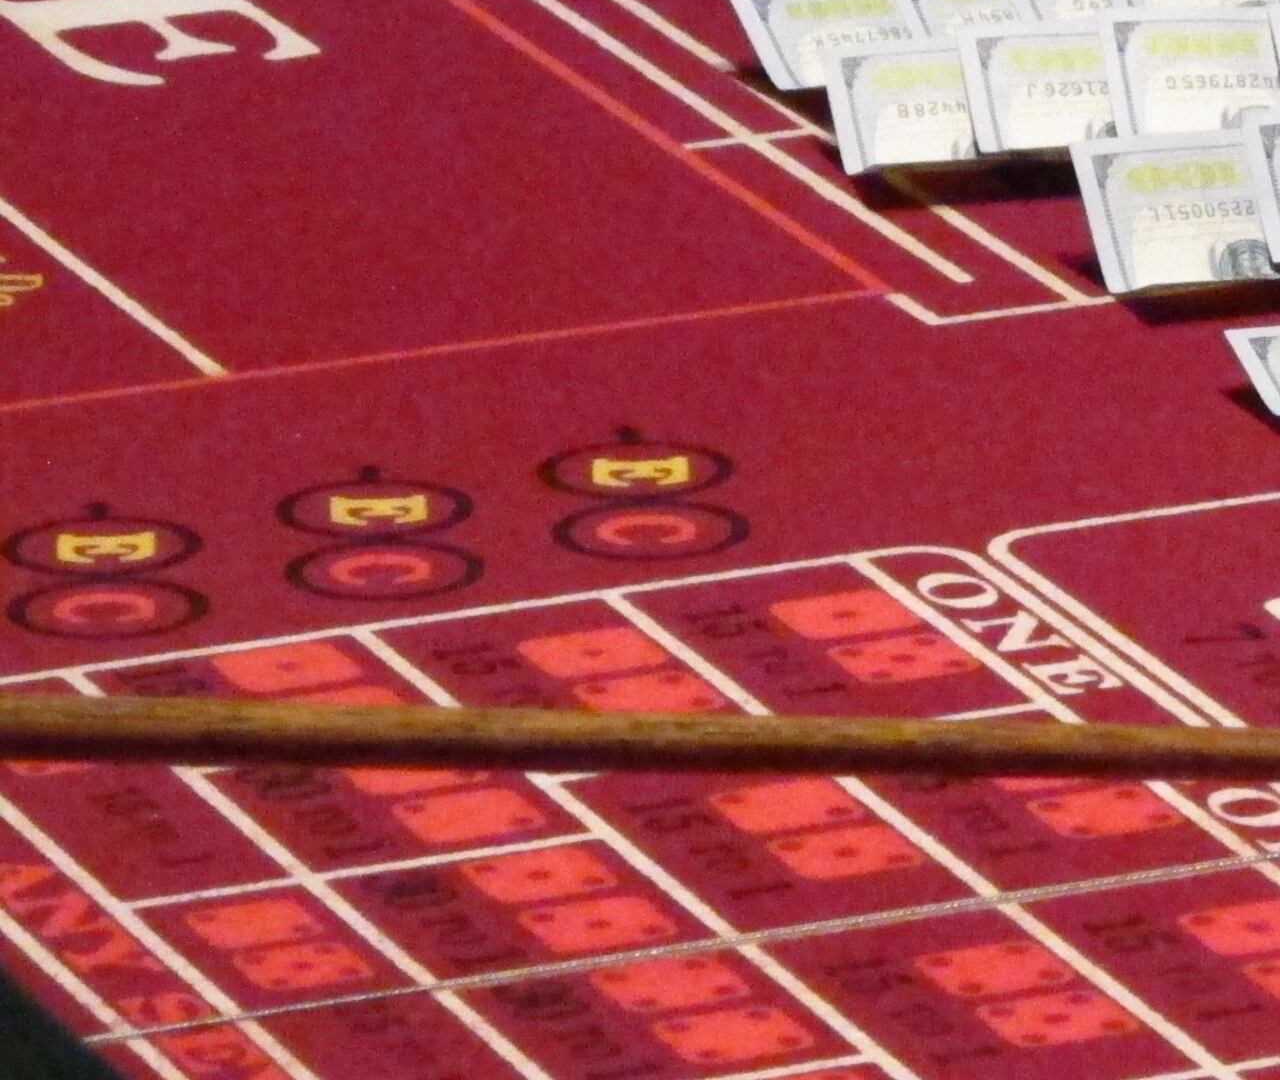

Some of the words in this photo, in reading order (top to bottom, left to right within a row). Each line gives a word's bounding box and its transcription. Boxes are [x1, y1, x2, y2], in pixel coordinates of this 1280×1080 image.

[592, 456, 690, 488] E
[330, 494, 429, 527] E
[596, 515, 698, 546] C
[57, 532, 157, 565] E
[329, 553, 432, 587] C
[53, 593, 157, 624] C
[914, 570, 1128, 699] ONE
